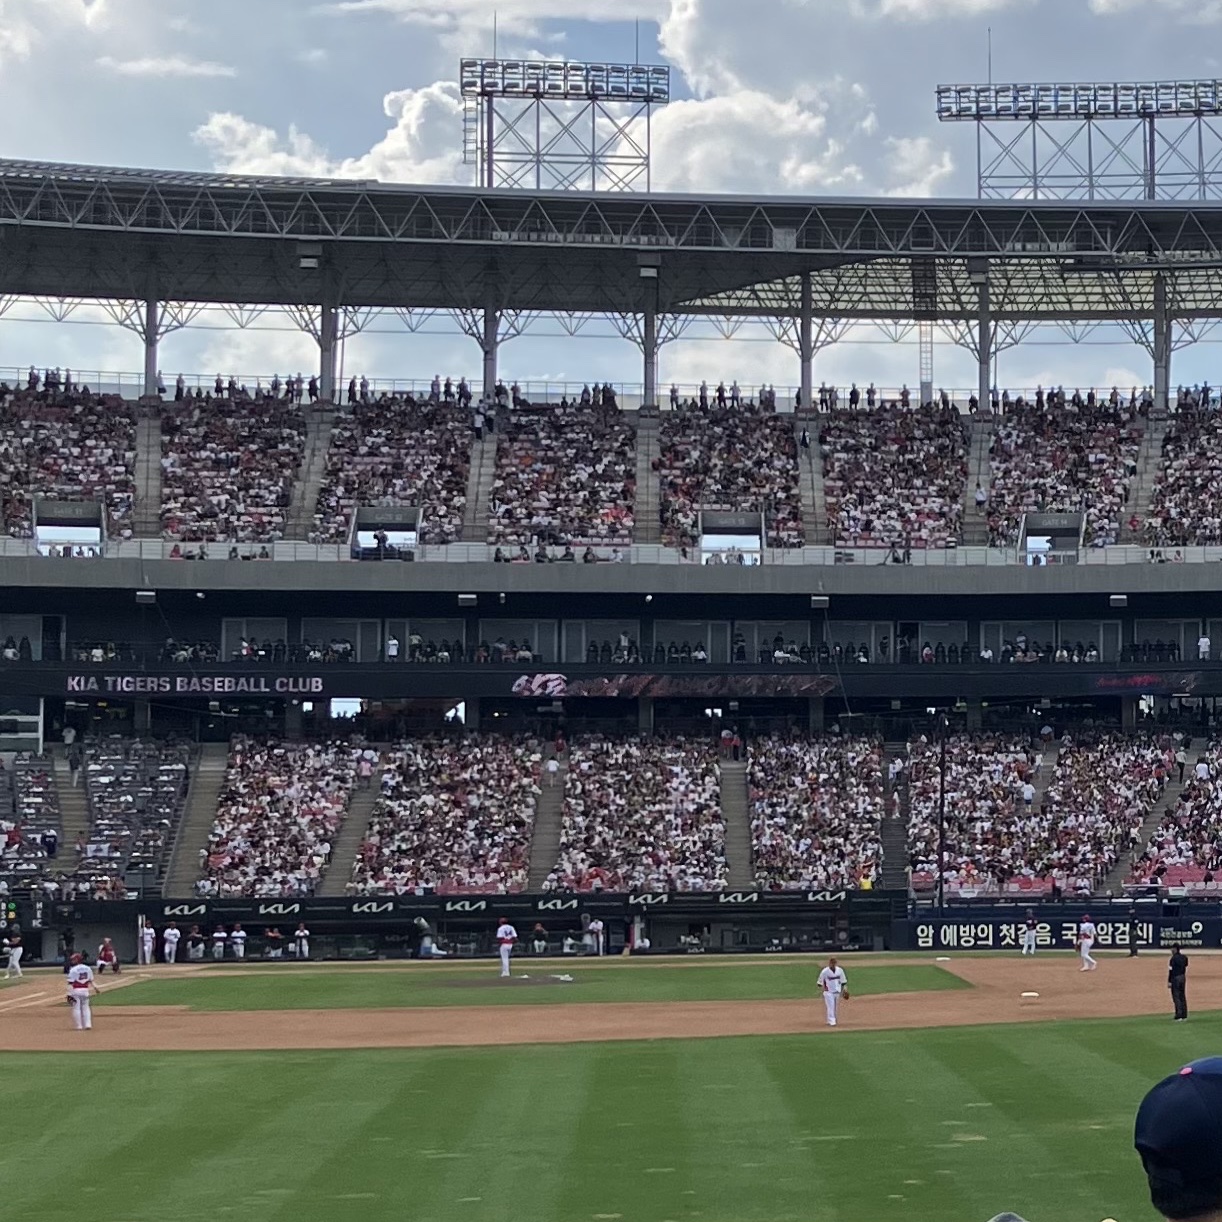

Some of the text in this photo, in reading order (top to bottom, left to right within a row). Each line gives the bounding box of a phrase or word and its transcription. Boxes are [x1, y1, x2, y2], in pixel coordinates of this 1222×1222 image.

[67, 676, 323, 692] KIA TIGERS BASEBALL CLUB
[917, 925, 934, 946] 암
[941, 924, 993, 946] 예방의
